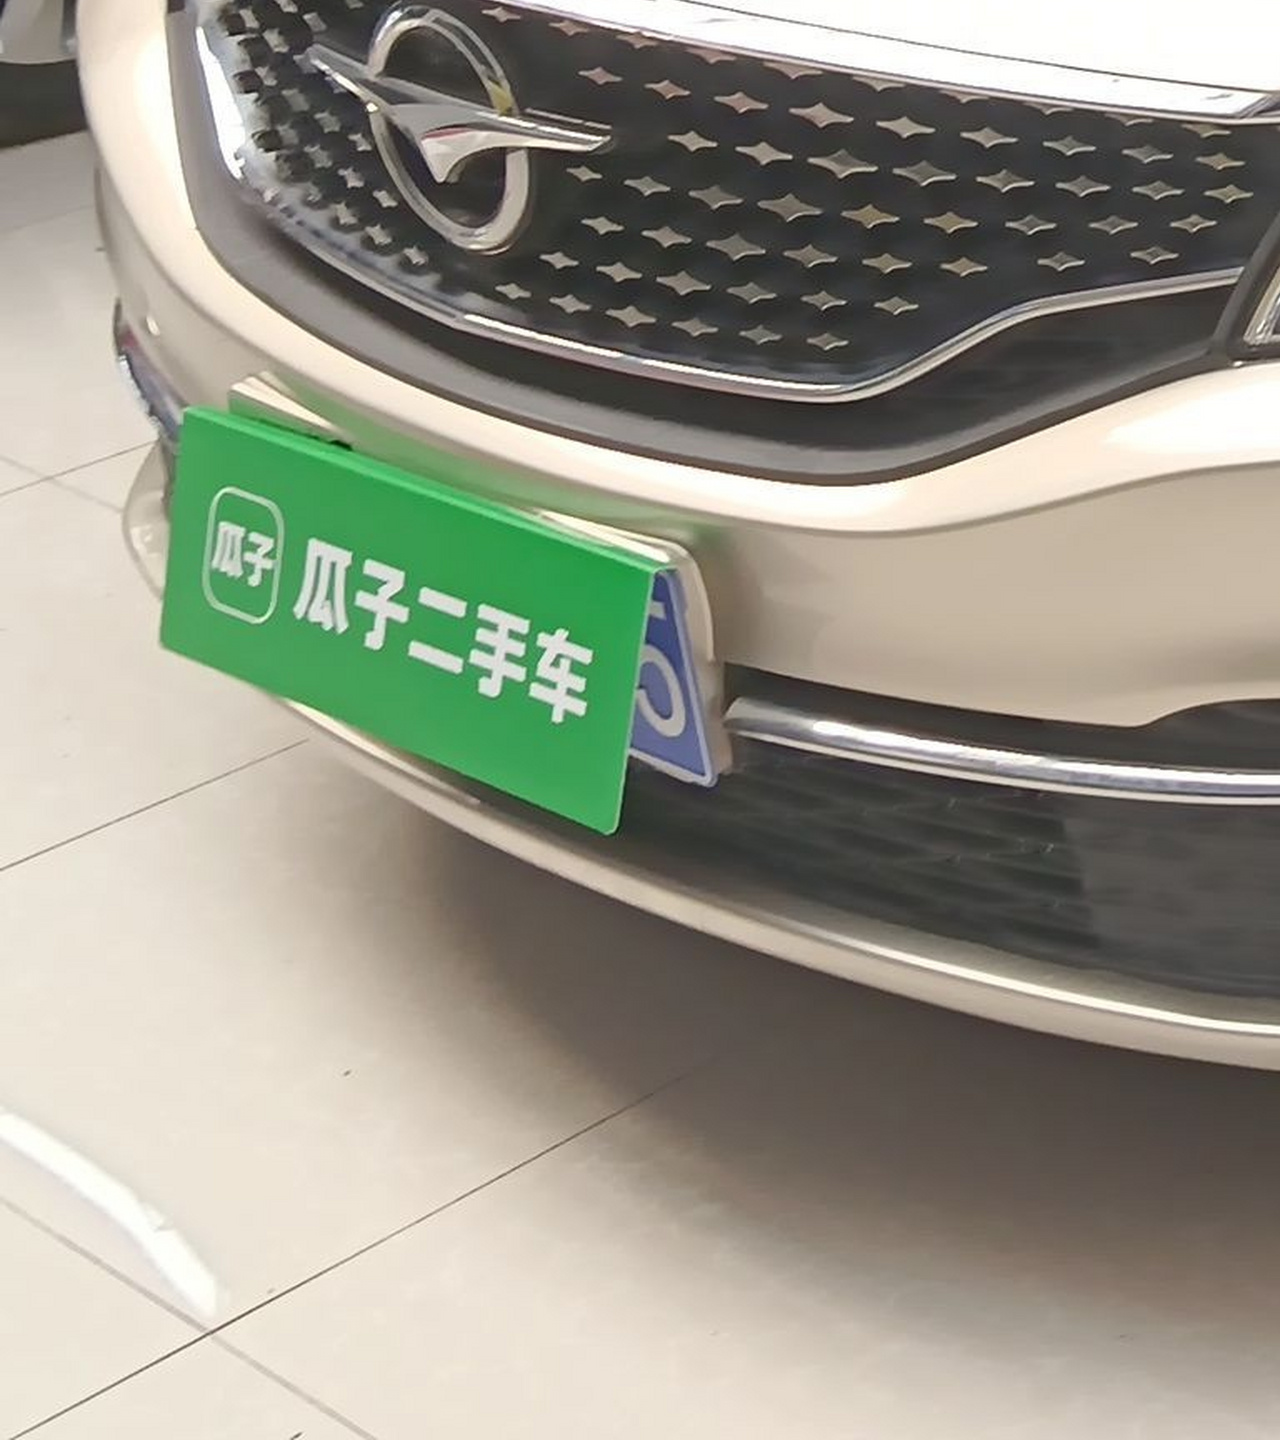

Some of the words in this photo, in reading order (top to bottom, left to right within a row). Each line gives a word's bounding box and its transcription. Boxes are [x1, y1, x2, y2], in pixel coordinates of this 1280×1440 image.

[211, 521, 275, 589] 瓜子
[293, 537, 594, 725] 瓜子二手车
